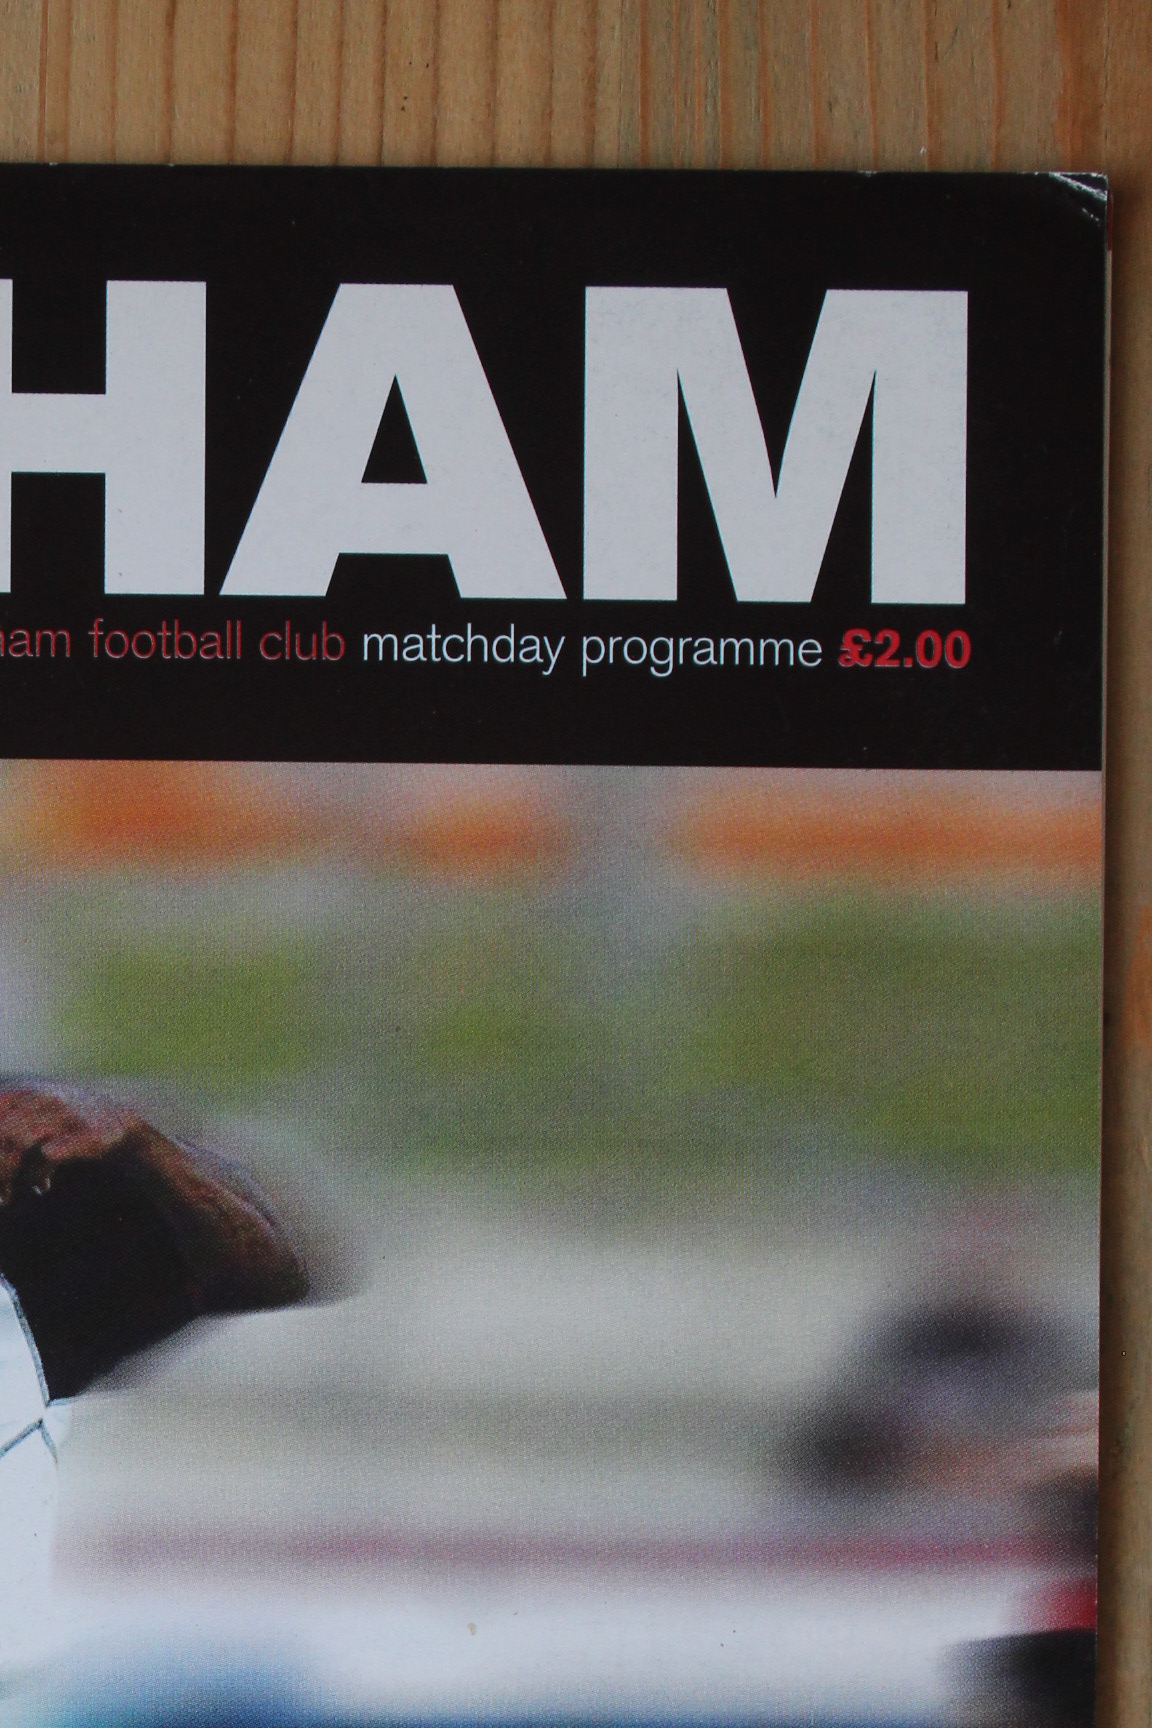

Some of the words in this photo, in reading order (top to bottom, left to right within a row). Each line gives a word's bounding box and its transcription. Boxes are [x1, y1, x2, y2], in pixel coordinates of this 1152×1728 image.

[88, 617, 242, 660] football
[260, 620, 346, 661] club
[363, 622, 566, 676] matchday
[583, 635, 823, 678] programme
[838, 627, 972, 669] £2.00
